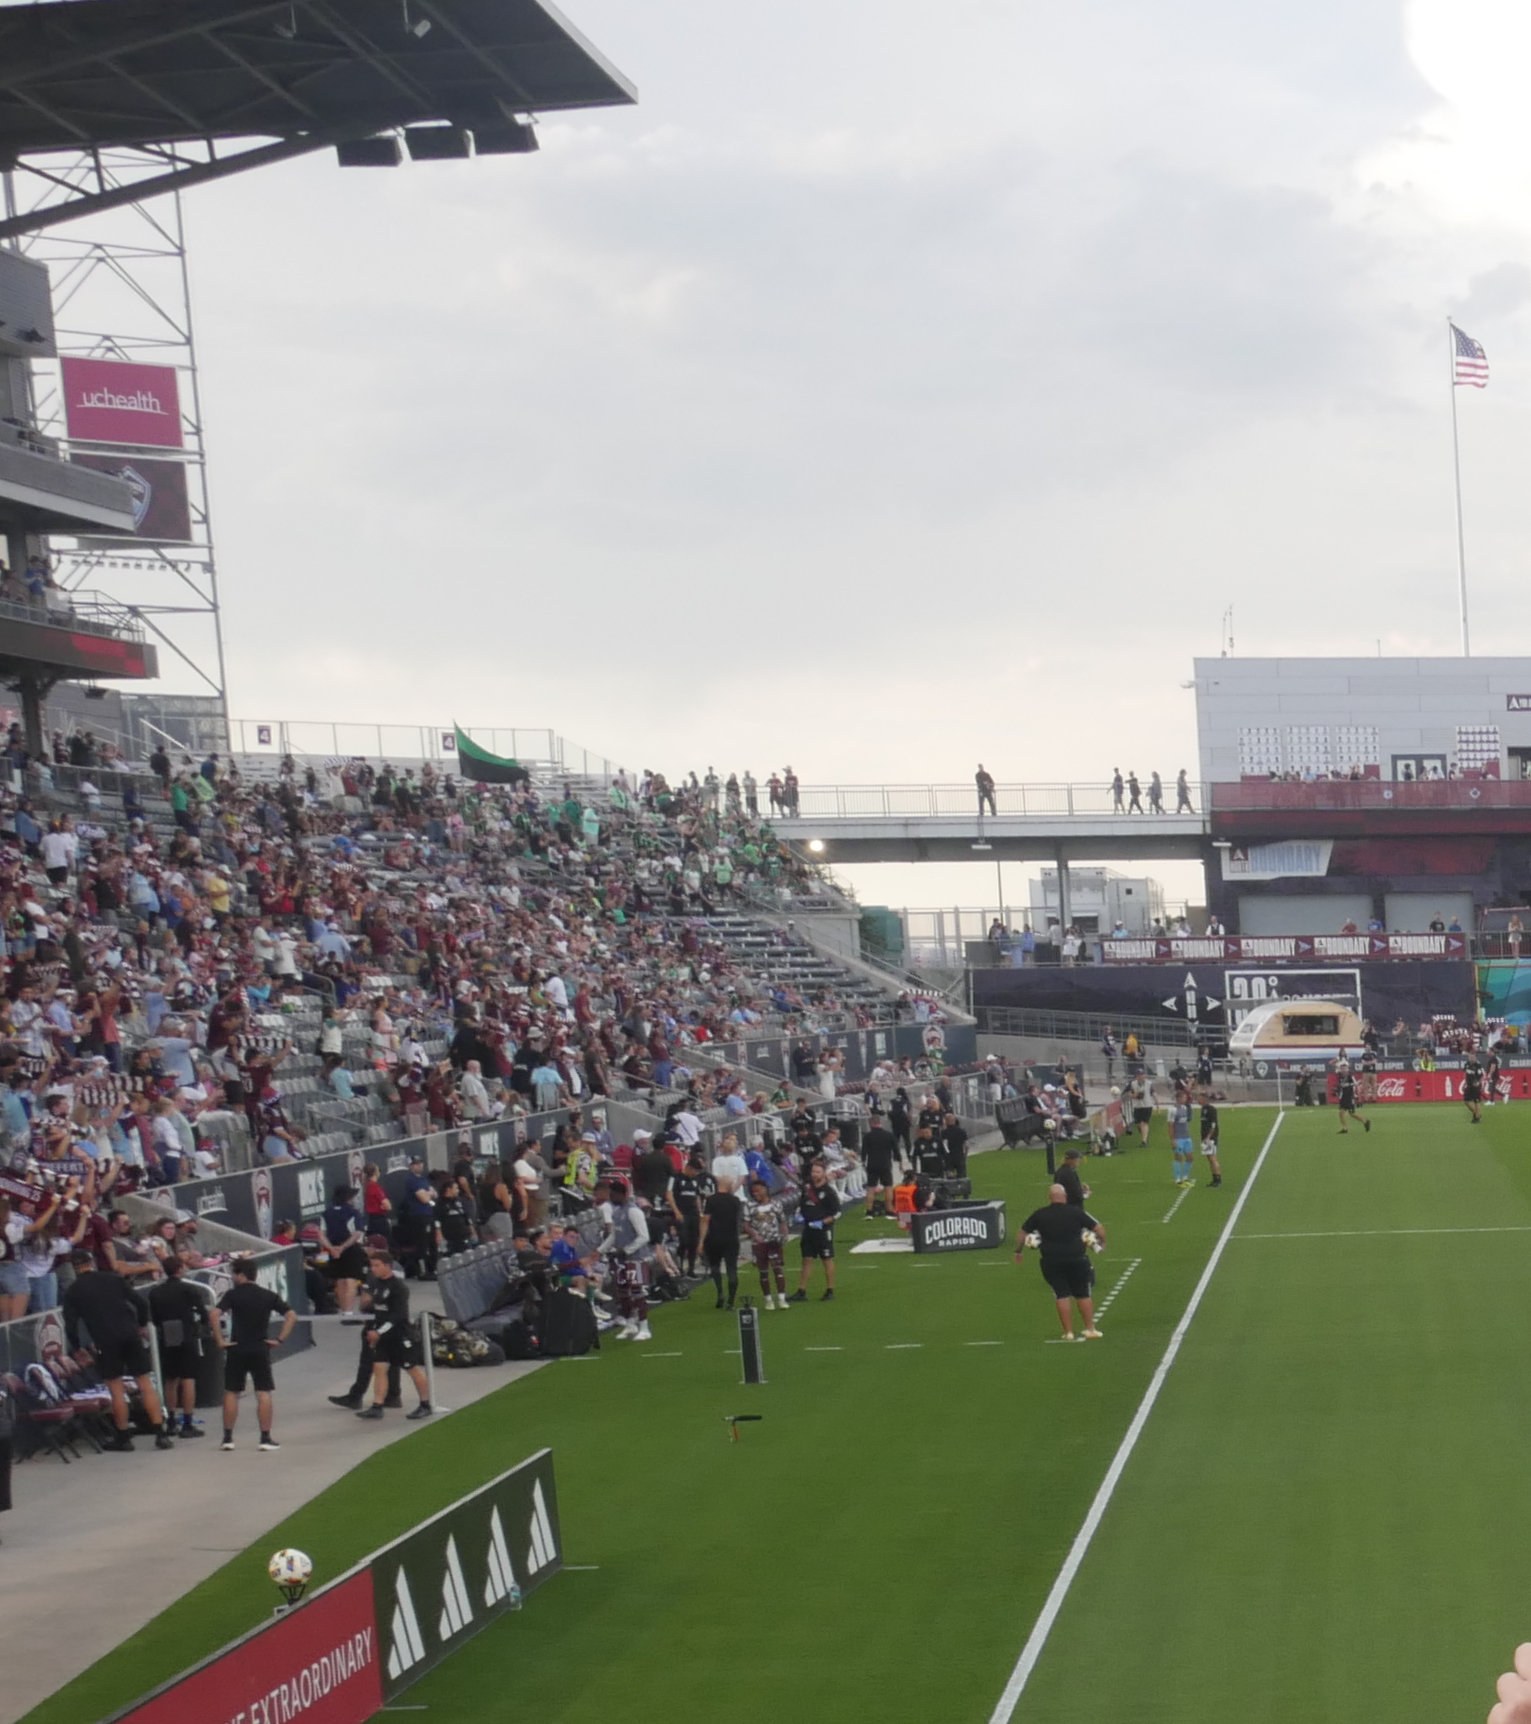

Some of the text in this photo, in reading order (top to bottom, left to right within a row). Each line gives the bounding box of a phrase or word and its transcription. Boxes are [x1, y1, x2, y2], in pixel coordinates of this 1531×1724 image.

[82, 387, 163, 413] uchealth
[259, 728, 269, 742] 4
[444, 736, 454, 749] 4
[1326, 936, 1370, 955] BOUNDARY
[1402, 935, 1446, 955] BOUNDARY
[925, 1216, 988, 1245] COLORADO
[938, 1237, 976, 1248] RAPIDS
